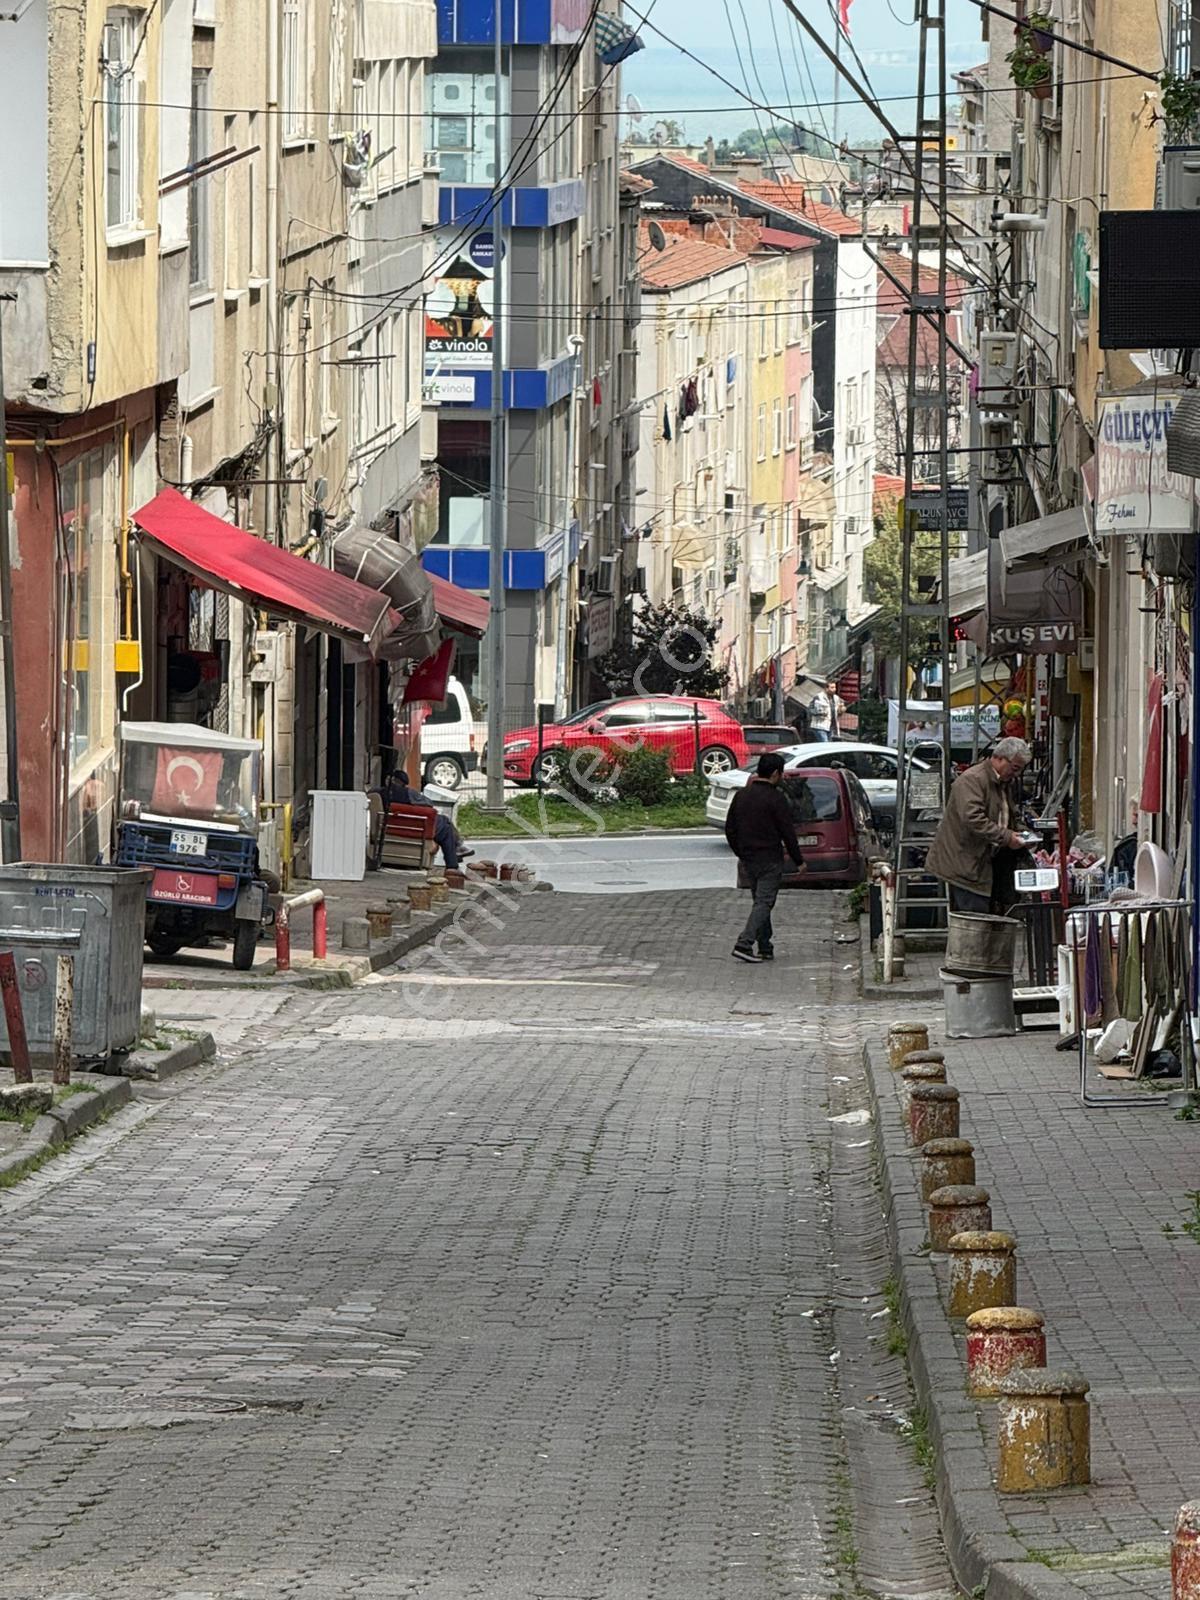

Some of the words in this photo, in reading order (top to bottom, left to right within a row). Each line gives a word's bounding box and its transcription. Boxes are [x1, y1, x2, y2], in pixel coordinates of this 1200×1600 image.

[445, 338, 488, 352] vinola
[441, 382, 472, 393] vinola
[1104, 402, 1173, 451] GÜLEÇYÜ
[1106, 503, 1136, 523] Fehmi
[991, 626, 1036, 646] KUŞ
[1040, 622, 1075, 641] EVİ
[174, 833, 186, 842] 55
[179, 845, 198, 853] 976
[154, 888, 181, 899] ÖZÜRLÜ
